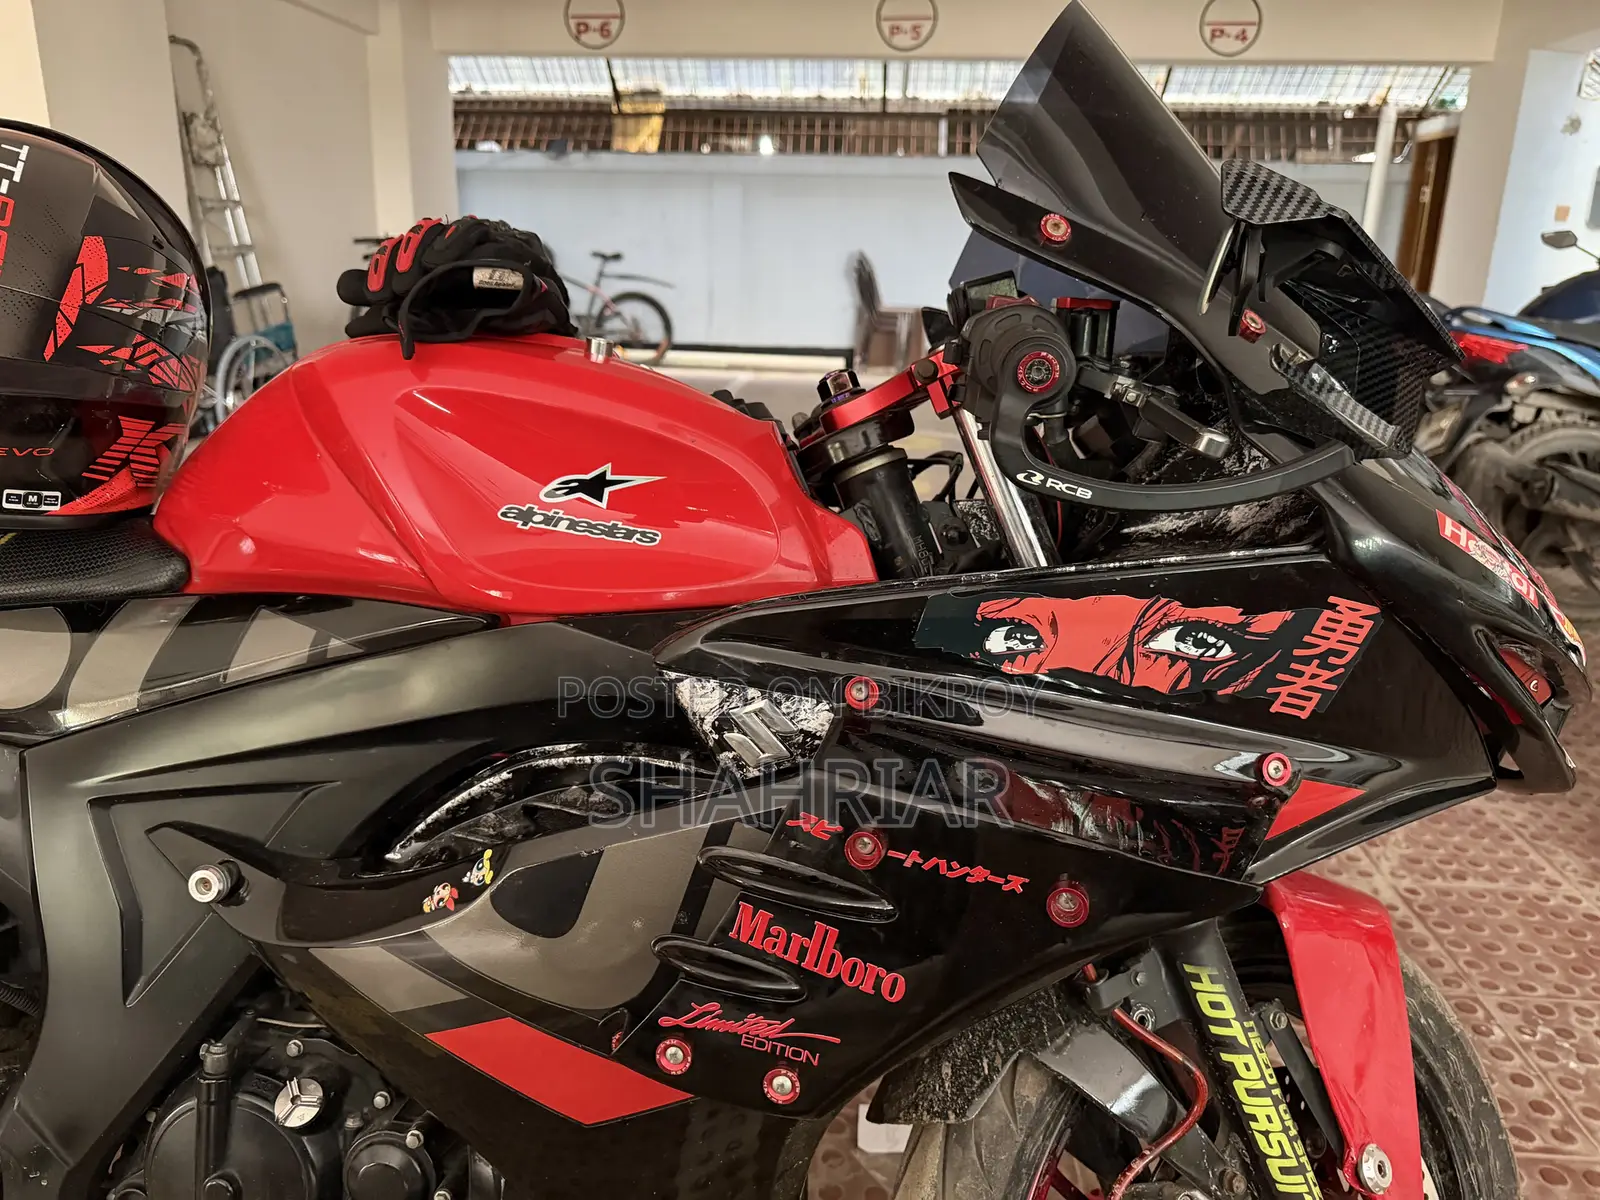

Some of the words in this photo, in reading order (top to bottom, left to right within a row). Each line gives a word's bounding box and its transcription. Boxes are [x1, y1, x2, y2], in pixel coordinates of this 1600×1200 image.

[575, 21, 611, 40] P-6
[1210, 28, 1249, 43] P-4
[1045, 477, 1093, 499] RCB
[499, 505, 661, 545] alpinestars
[1266, 596, 1381, 719] 勇者
[728, 900, 907, 1003] Marlboro
[658, 1001, 842, 1045] Limited
[740, 1033, 821, 1067] EDITION
[1182, 963, 1250, 1048] HOT
[1220, 1052, 1313, 1200] PURSUI
[1270, 1086, 1299, 1137] FOR
